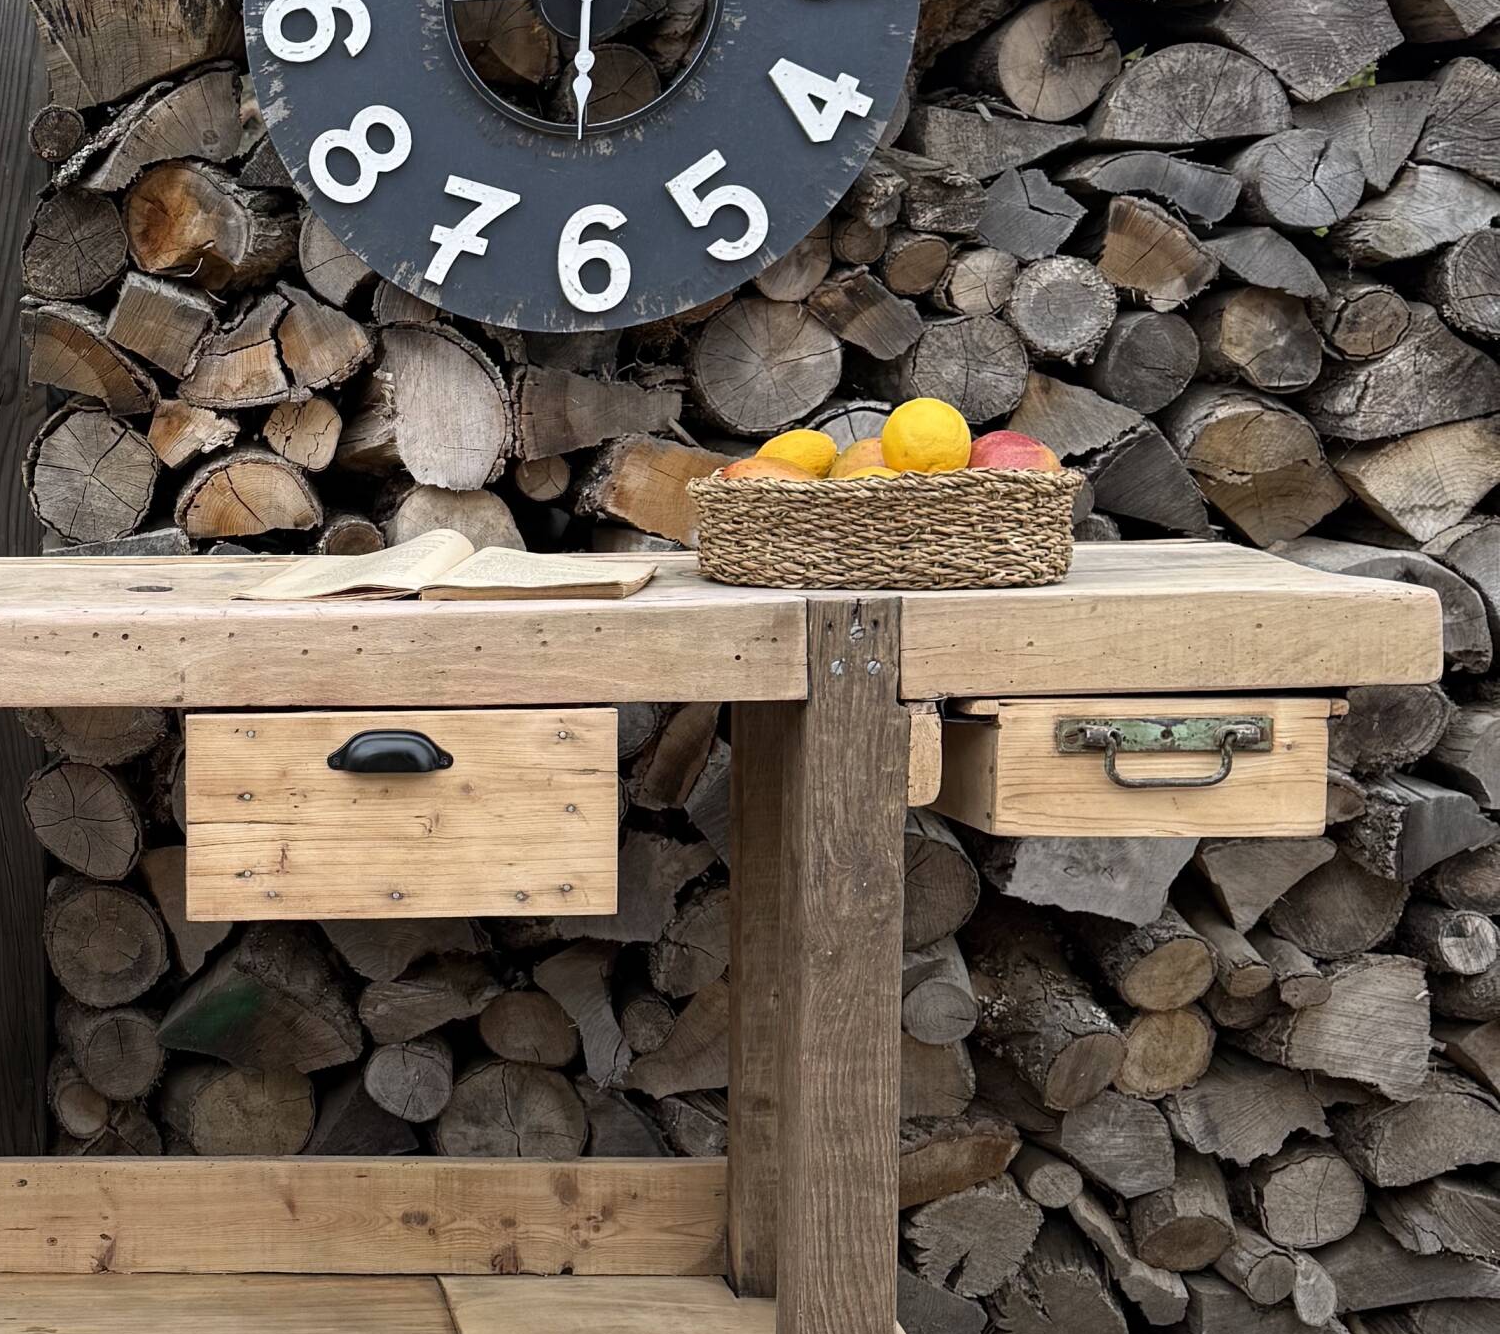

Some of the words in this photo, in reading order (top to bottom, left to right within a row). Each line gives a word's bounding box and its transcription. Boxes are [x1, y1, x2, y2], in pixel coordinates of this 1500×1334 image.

[309, 105, 411, 203] 8
[768, 58, 873, 143] 4
[424, 175, 520, 285] 7
[557, 204, 631, 312] 6
[665, 149, 769, 261] 5
